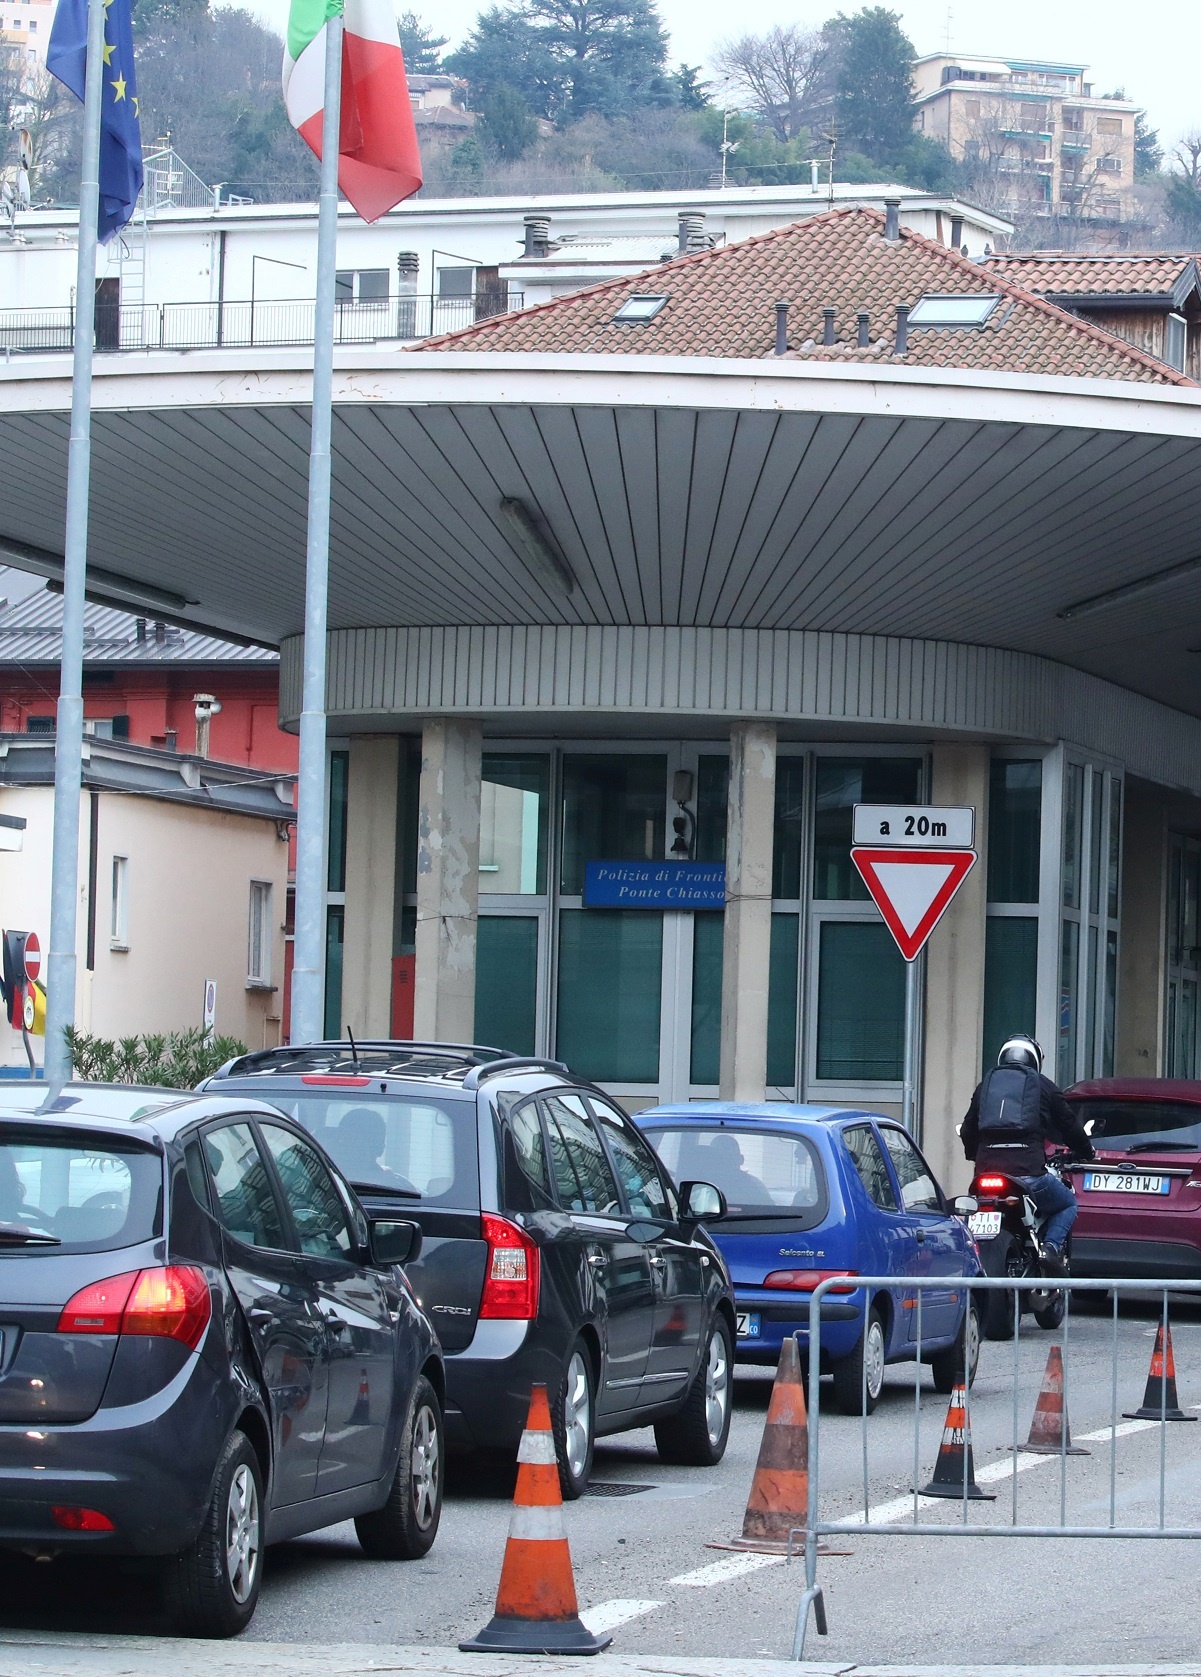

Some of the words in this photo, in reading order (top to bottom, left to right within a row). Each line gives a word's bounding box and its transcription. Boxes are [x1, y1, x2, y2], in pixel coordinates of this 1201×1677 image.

[880, 821, 890, 835] a
[904, 815, 947, 836] 20m
[597, 869, 649, 881] Polizia
[655, 870, 669, 882] di
[618, 886, 661, 898] Ponte
[666, 887, 725, 899] Chiasso
[1093, 1175, 1110, 1188] DY
[1116, 1176, 1161, 1191] 281WJ
[979, 1213, 990, 1222] TI
